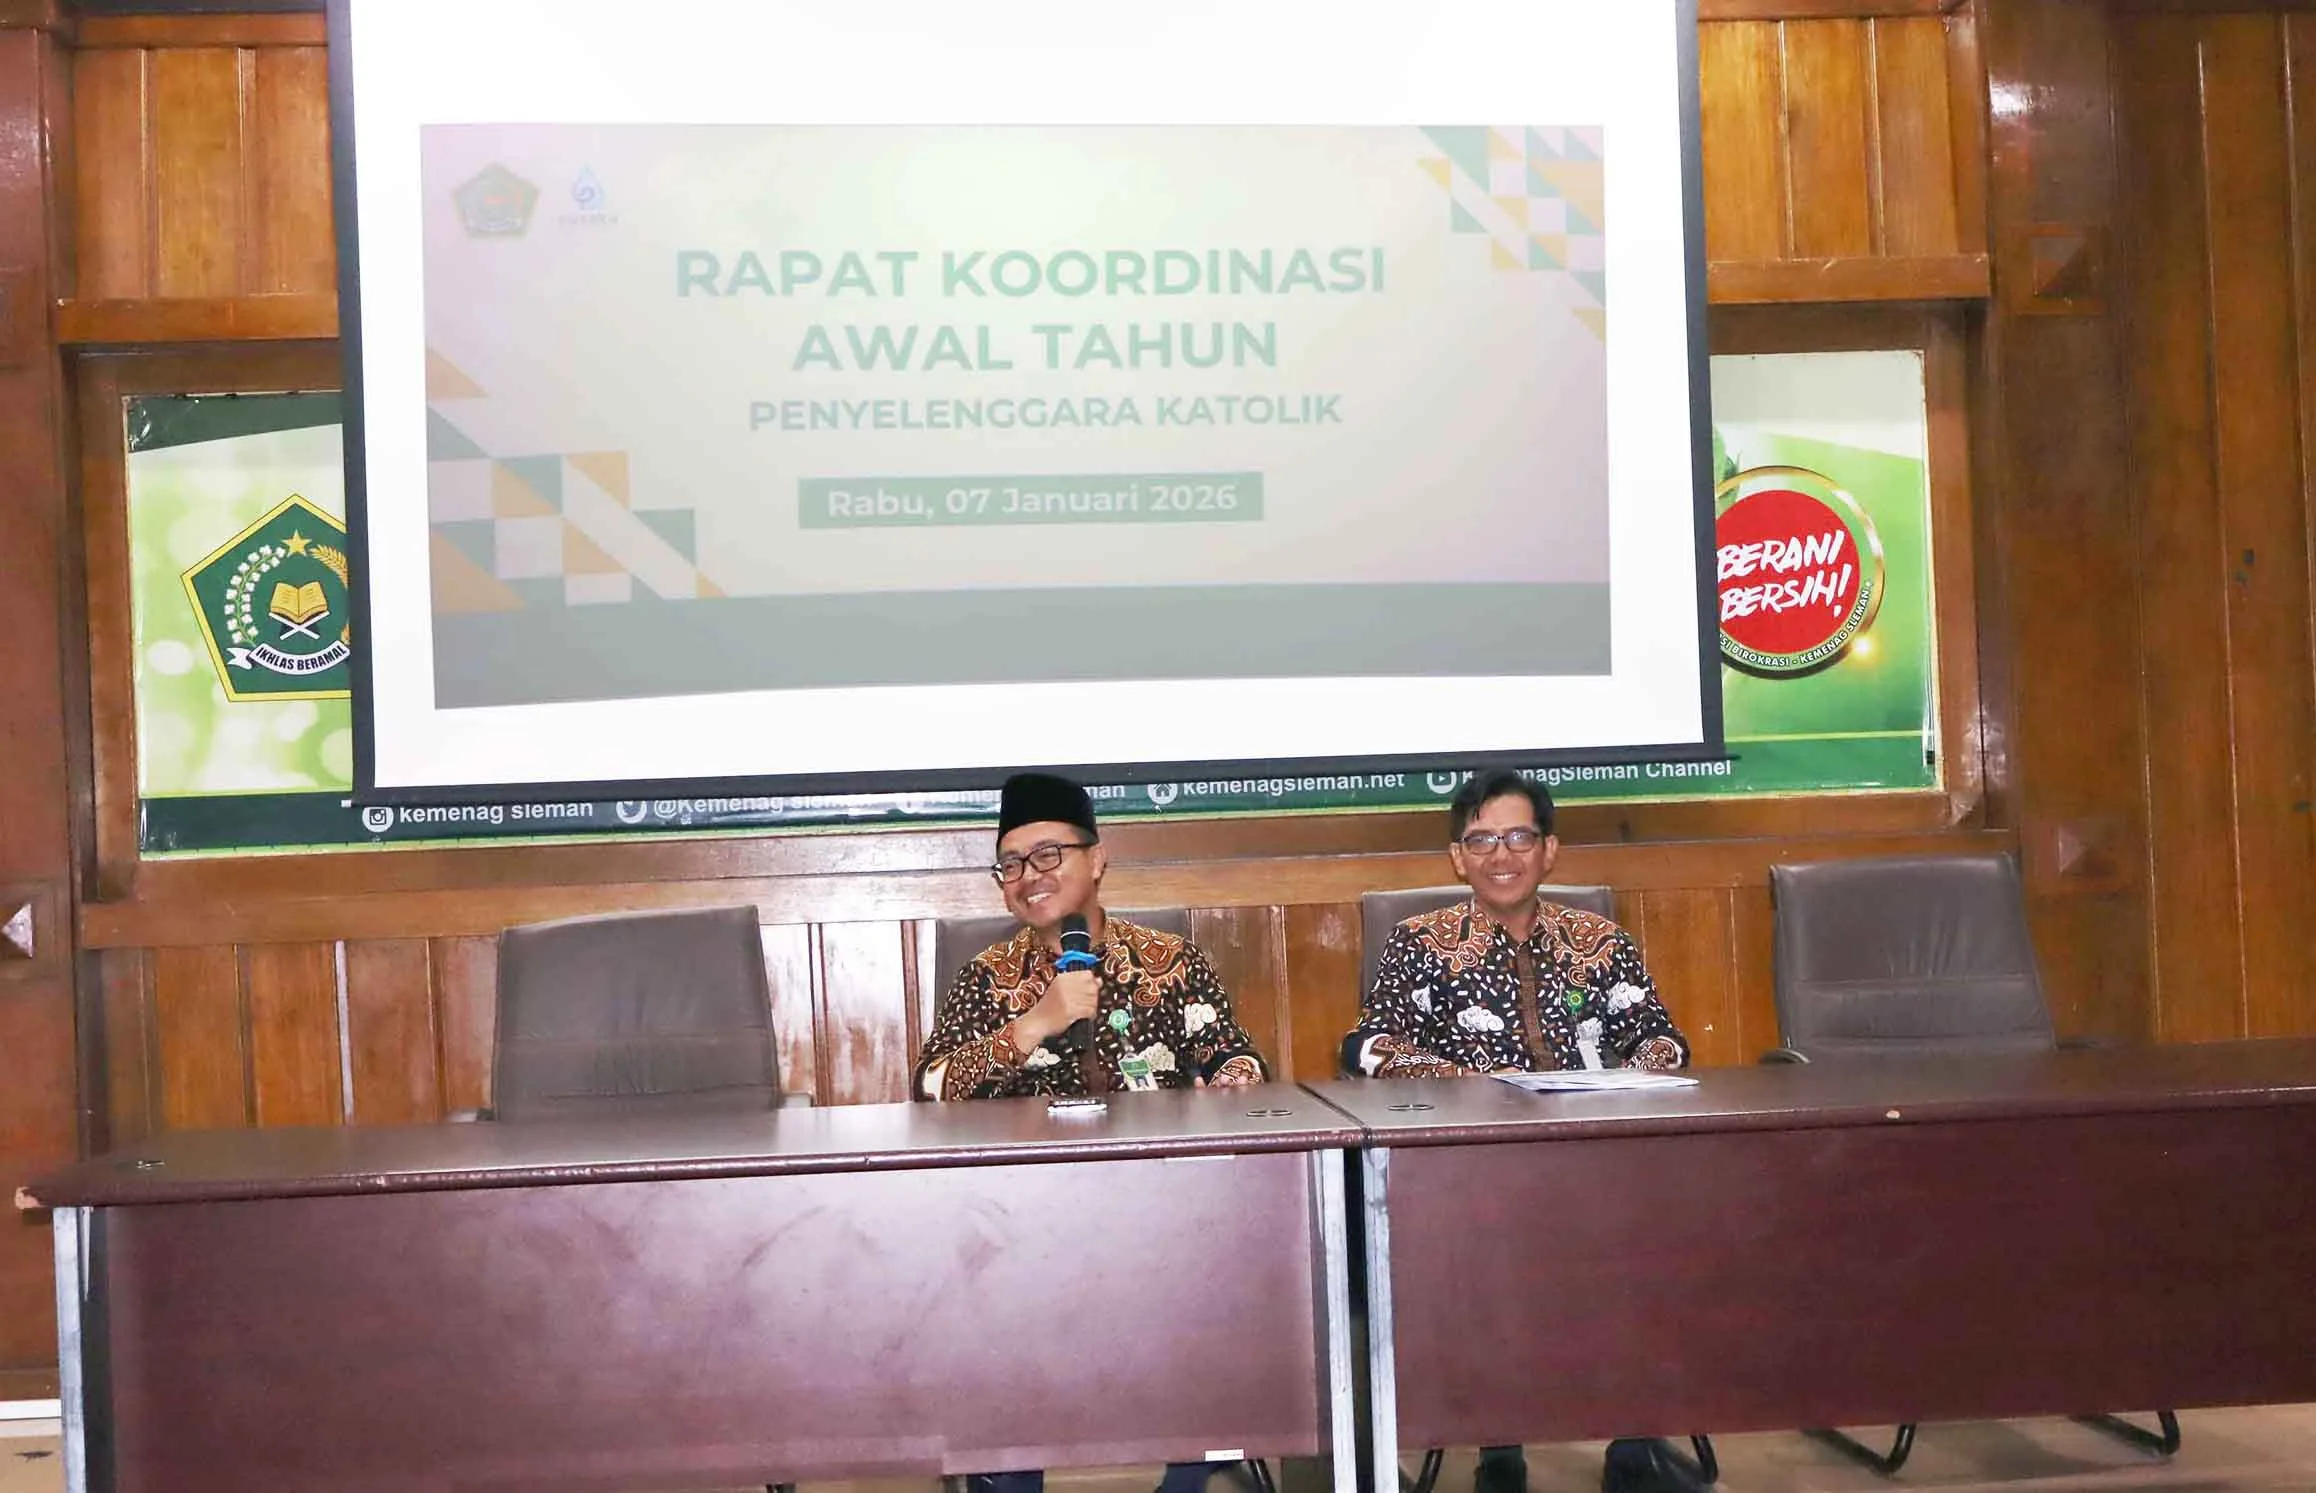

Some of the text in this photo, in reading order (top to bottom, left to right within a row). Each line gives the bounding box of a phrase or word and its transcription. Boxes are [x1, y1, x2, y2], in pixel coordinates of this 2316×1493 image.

[676, 246, 1386, 298] RAPAT KOORDINASI
[791, 321, 1277, 371] AWAL TAHUN
[749, 394, 1344, 431] PENYELENGGARA KATOLIK
[828, 483, 1239, 519] Rabu, 07 Januari 2026
[1716, 529, 1845, 584] BERANI
[1719, 563, 1852, 622] BERSIH!
[1731, 645, 1790, 666] BIROKRASI
[1799, 630, 1848, 664] KEMENAG
[1845, 589, 1870, 632] SLEMAN
[255, 645, 347, 670] IKHLAS BERAMAL
[1645, 759, 1732, 778] Channel
[400, 802, 594, 825] kemenag sleman
